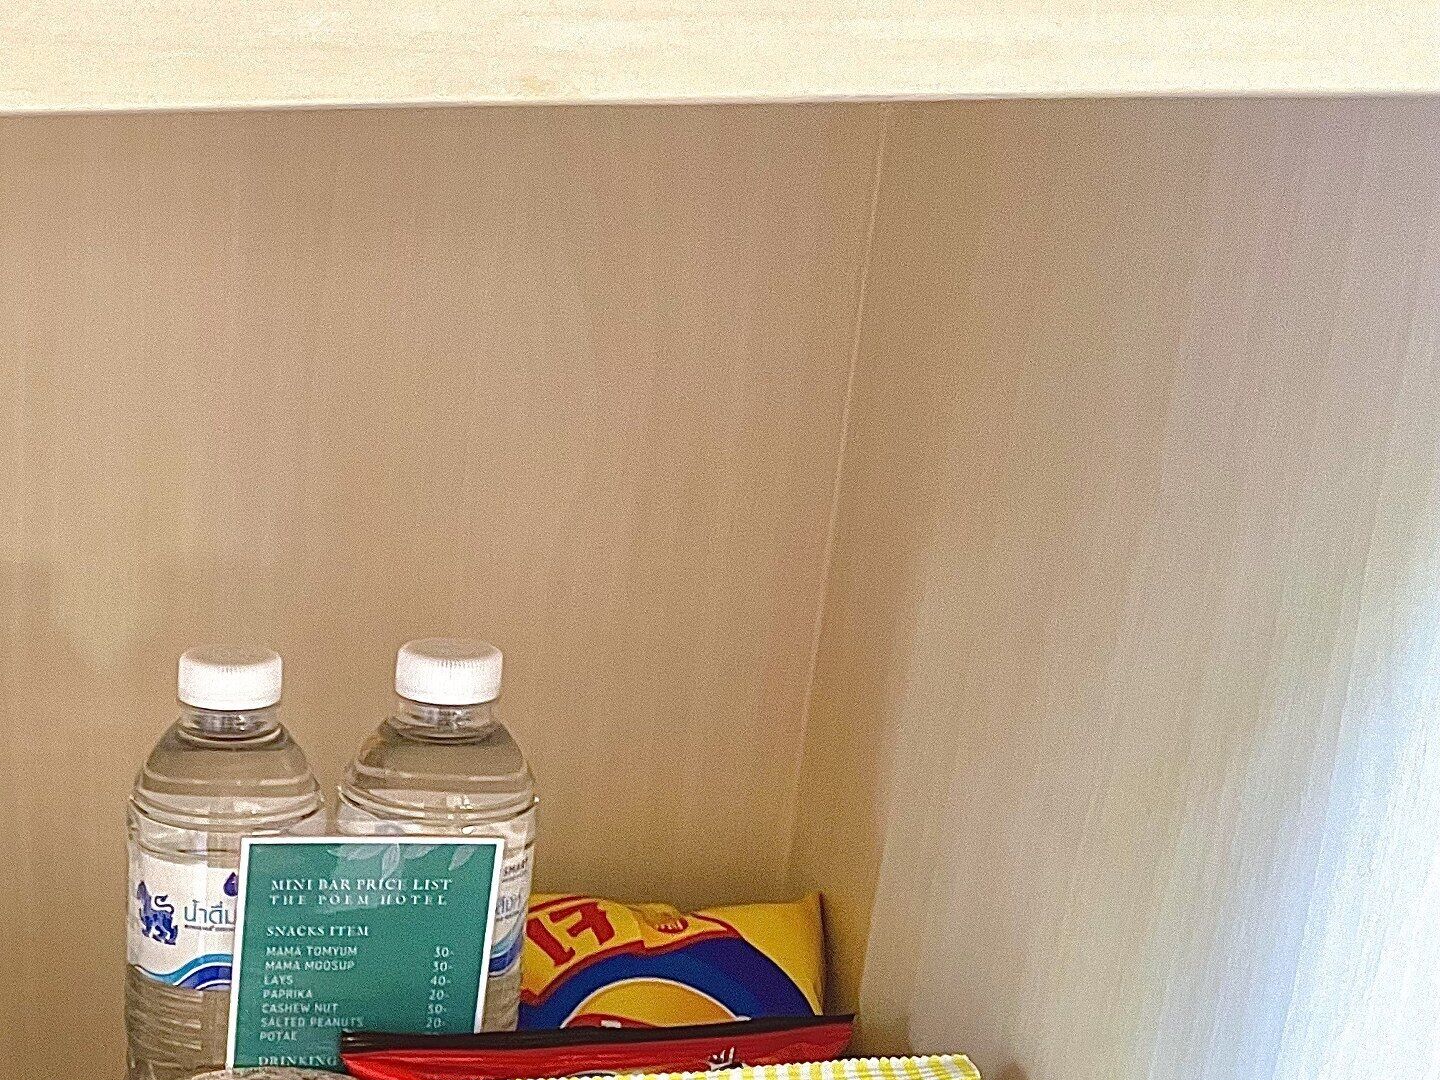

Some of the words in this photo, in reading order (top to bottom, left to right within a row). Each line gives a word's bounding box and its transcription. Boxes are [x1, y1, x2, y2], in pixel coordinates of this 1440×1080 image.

[271, 879, 313, 891] MINI
[318, 879, 351, 891] BAR
[357, 879, 406, 891] PRICE
[413, 878, 453, 891] LIST
[269, 894, 307, 906] THE
[318, 894, 369, 906] POEM
[380, 894, 448, 906] HOTEL
[266, 925, 325, 937] SNACKS
[329, 925, 369, 937] ITEM
[265, 946, 302, 957] MAMA
[306, 946, 358, 957] TOMYUM
[264, 960, 301, 972] MAMA
[304, 960, 355, 971] MOOSUP
[263, 975, 294, 986] LAYS
[262, 989, 314, 1000] PAPRIKA
[261, 1002, 311, 1014] CASHEW
[315, 1003, 339, 1013] NUT
[260, 1017, 306, 1028] SALTED
[258, 1055, 338, 1067] DRINKING
